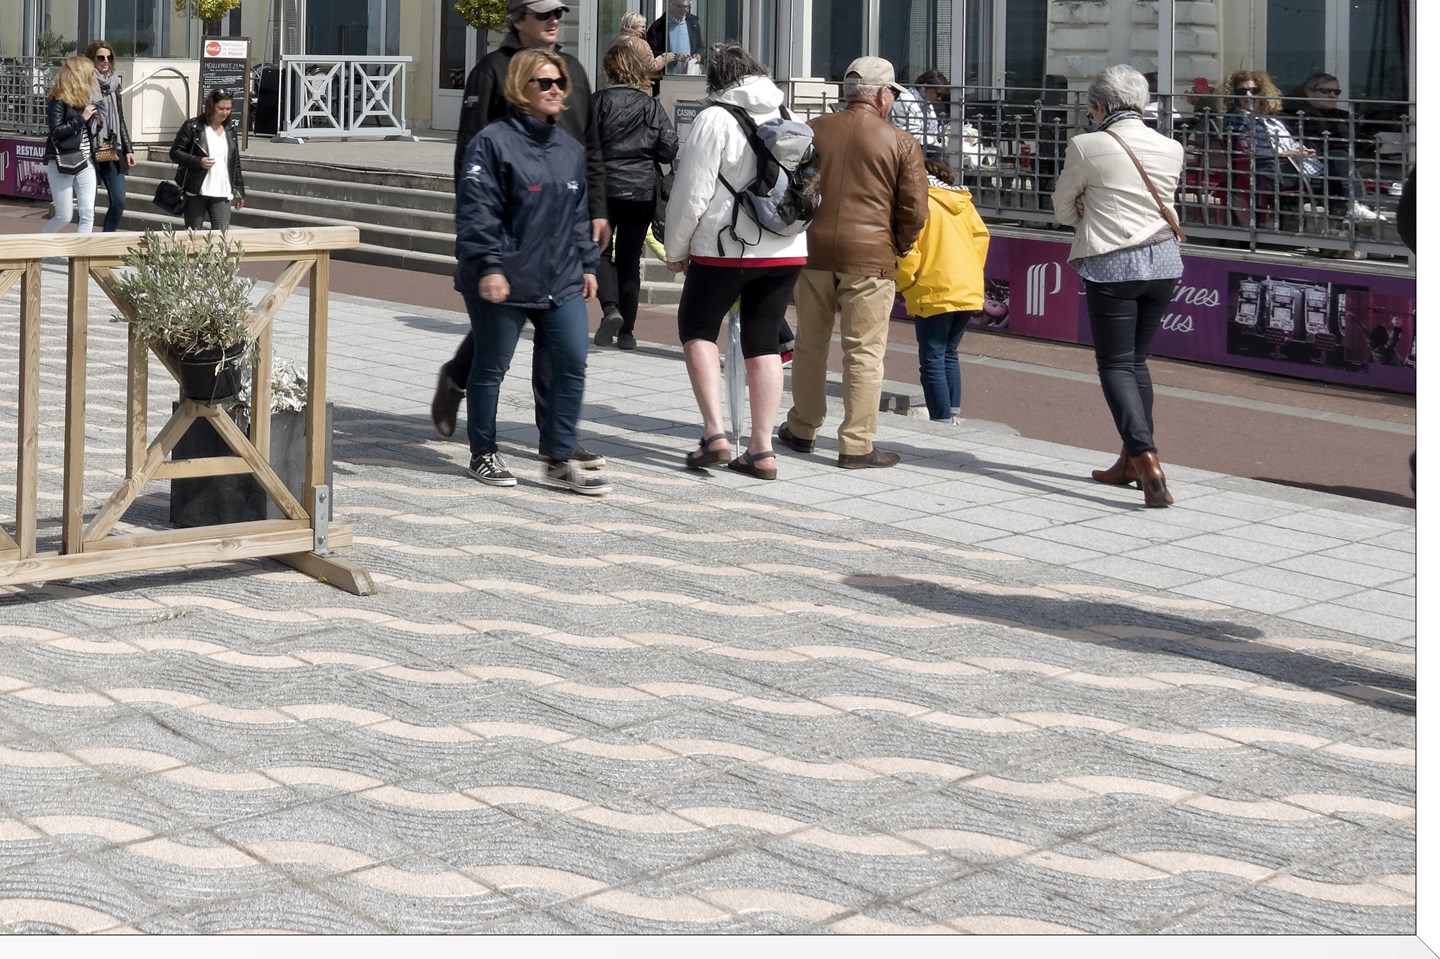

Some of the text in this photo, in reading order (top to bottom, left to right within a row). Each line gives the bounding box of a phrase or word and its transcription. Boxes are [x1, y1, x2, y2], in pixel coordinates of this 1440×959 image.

[676, 108, 697, 118] CASINO
[16, 145, 47, 160] RESTAU
[1170, 279, 1221, 307] ines
